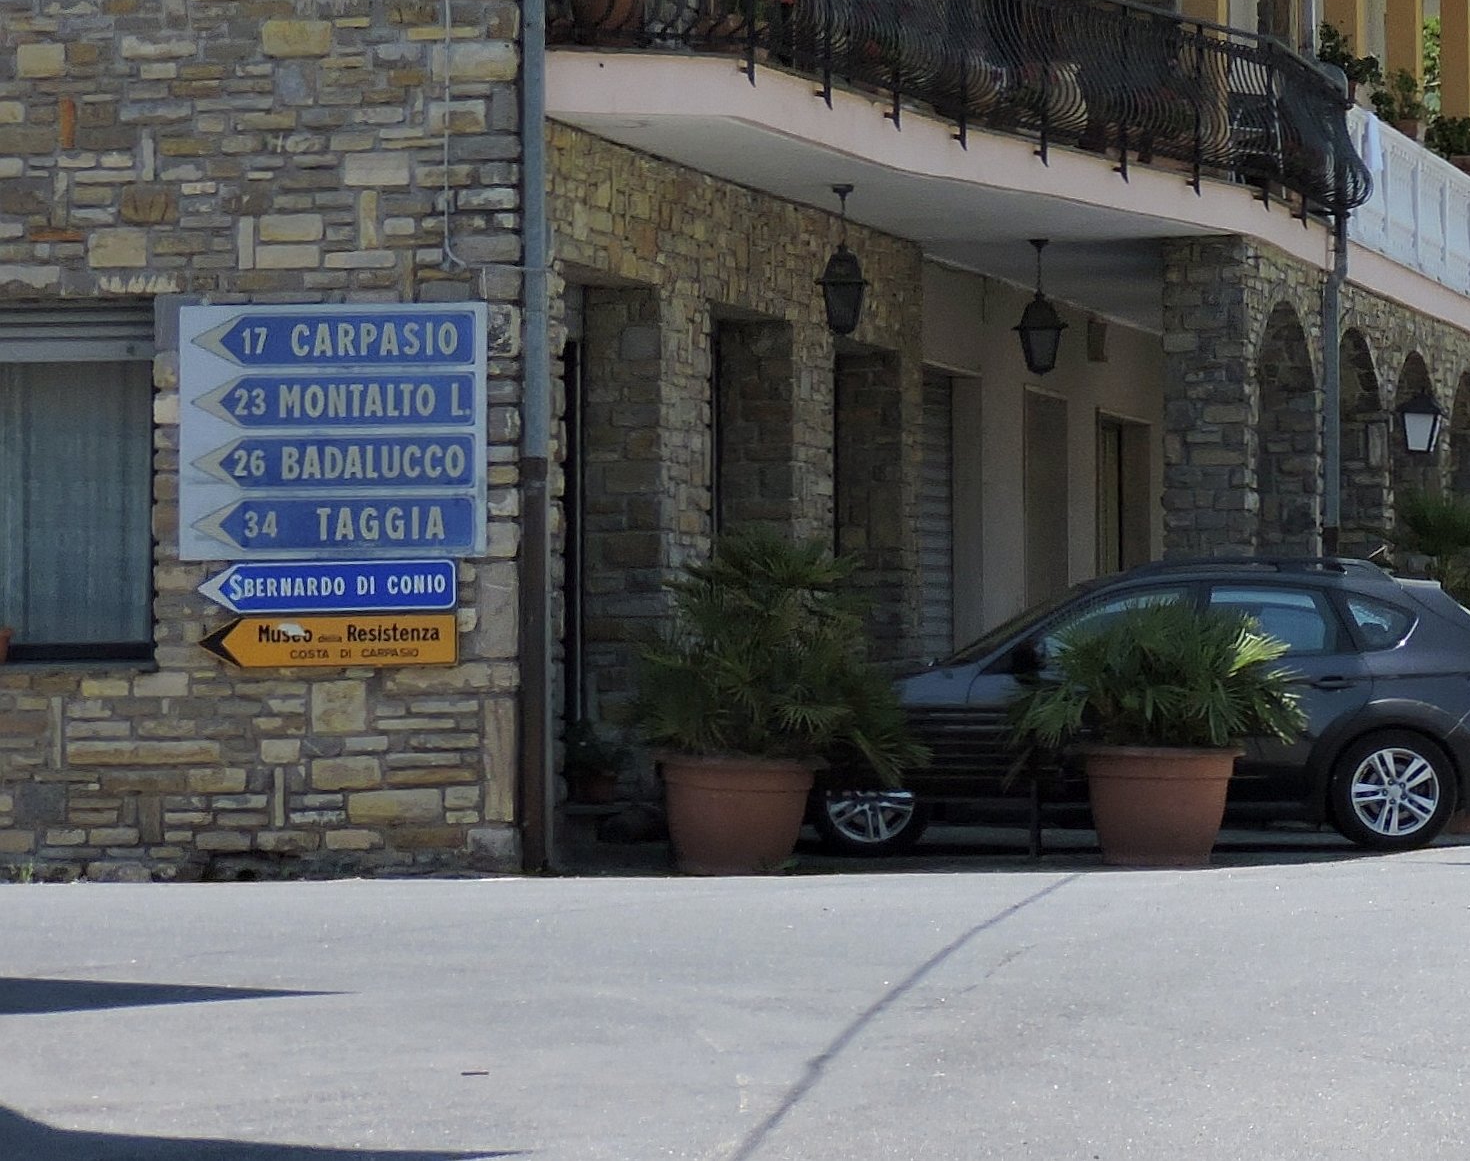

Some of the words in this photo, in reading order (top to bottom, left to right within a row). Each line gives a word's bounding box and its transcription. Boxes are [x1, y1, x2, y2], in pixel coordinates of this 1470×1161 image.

[242, 327, 268, 354] 17
[291, 321, 459, 356] CARPASIO
[233, 388, 267, 415] 23
[279, 383, 436, 418] MONTALTO
[451, 383, 472, 417] L.
[233, 449, 266, 476] 26
[281, 445, 466, 480] BADALUCCO
[244, 511, 277, 538] 34
[316, 505, 446, 541] TAGGIA
[356, 576, 375, 595] DI
[387, 574, 446, 595] CONIO
[347, 624, 440, 643] Resistenza
[290, 649, 329, 659] COSTA
[340, 648, 352, 659] DI
[361, 647, 419, 659] CARPASIO
